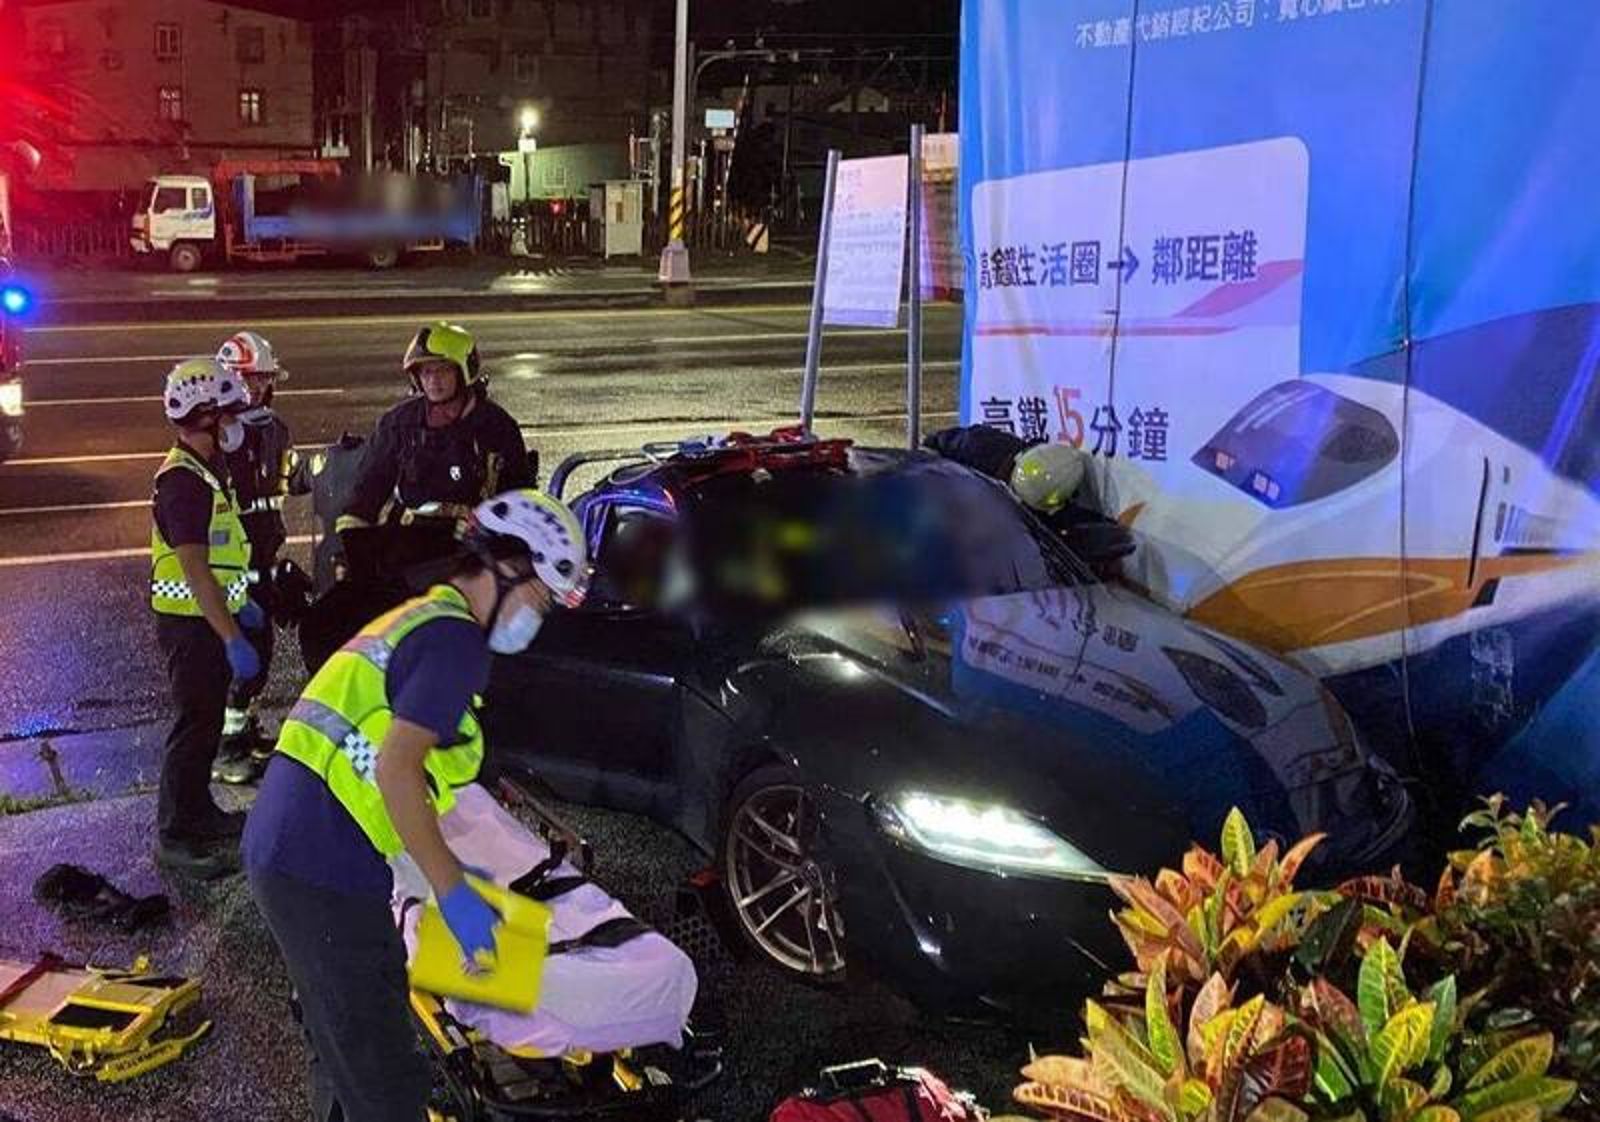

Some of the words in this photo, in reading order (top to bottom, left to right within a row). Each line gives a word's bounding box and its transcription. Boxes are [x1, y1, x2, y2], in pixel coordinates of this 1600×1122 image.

[979, 240, 1101, 290] 高鐵生活圈
[1151, 229, 1258, 286] 鄰距離
